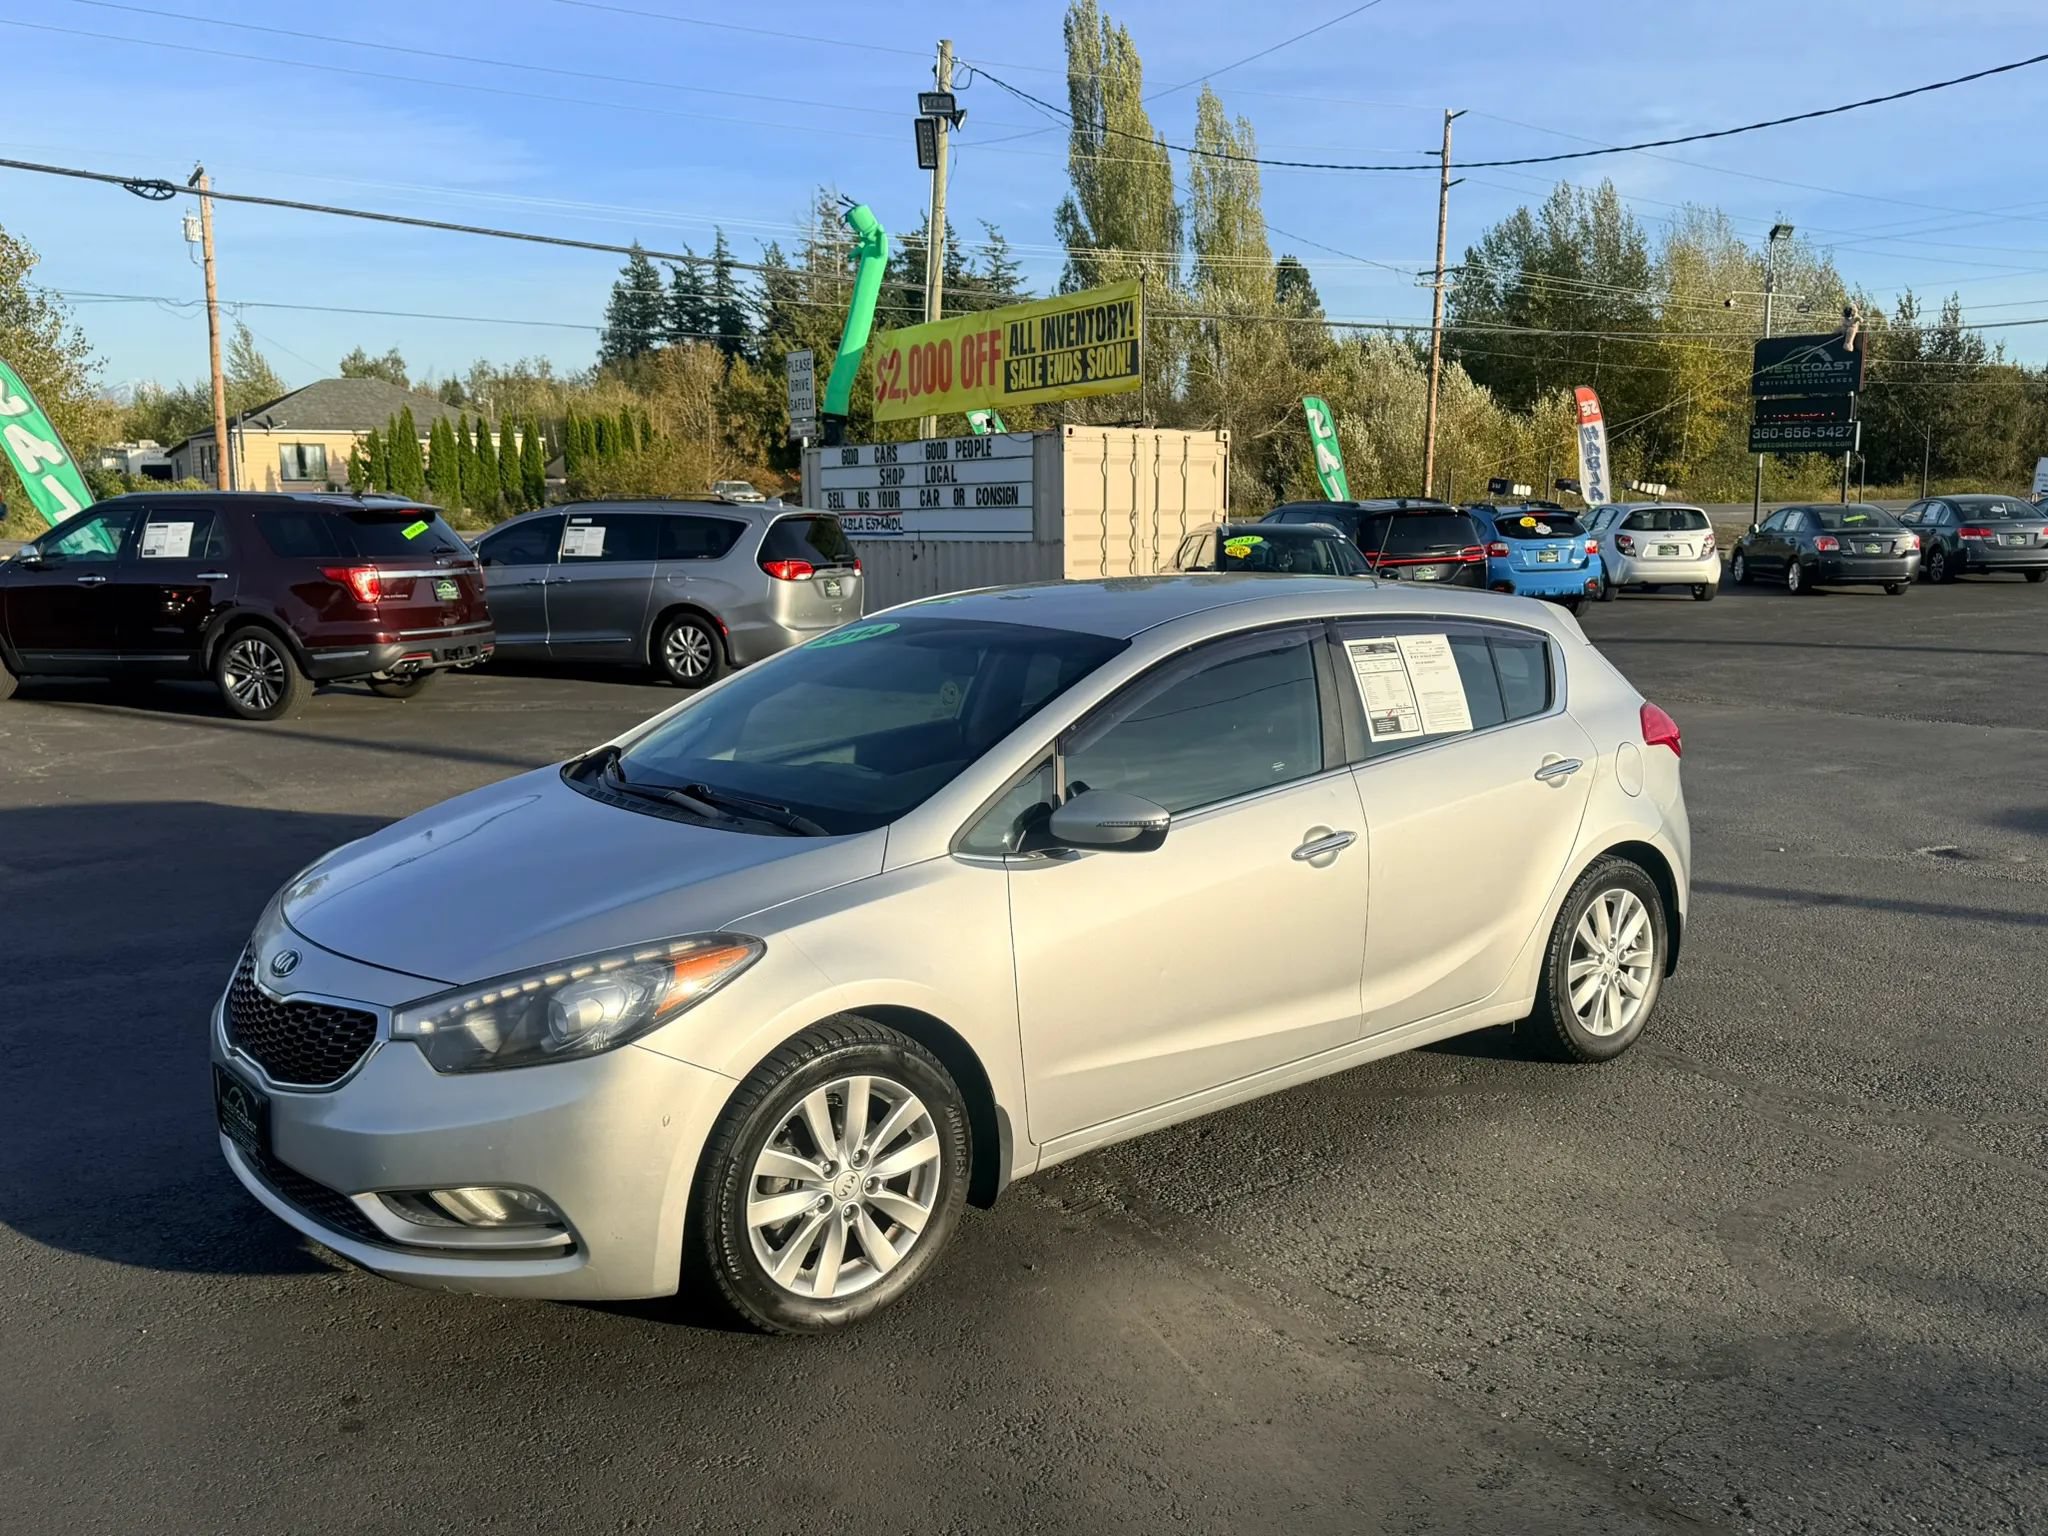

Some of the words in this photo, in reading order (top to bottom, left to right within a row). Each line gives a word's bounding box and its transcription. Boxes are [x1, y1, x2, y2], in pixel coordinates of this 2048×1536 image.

[1009, 321, 1035, 357] ALL
[1041, 301, 1134, 351] INVENTORY!
[787, 358, 811, 373] PLEASE
[875, 338, 952, 404] $2,000
[960, 329, 1002, 389] OFF
[1009, 356, 1042, 390] SALE
[1047, 349, 1082, 385] ENDS
[1087, 341, 1132, 379] SOON!
[1761, 361, 1854, 374] WESTCOAST
[791, 378, 810, 392] DRIVE
[790, 397, 812, 412] SAFELY
[1752, 426, 1854, 439] 360-656-5427
[841, 448, 859, 465] GOOD
[874, 445, 898, 464] CARS
[925, 441, 948, 460] GOOD
[955, 438, 992, 458] PEOPLE
[879, 467, 905, 486] SHOP
[924, 464, 958, 484] LOCAL
[827, 492, 846, 509] SELL
[858, 491, 870, 508] US
[877, 490, 900, 508] YOUR
[919, 488, 940, 506] CAR
[953, 488, 965, 506] OR
[976, 486, 1019, 506] CONSIGN
[838, 1174, 856, 1197] KIA
